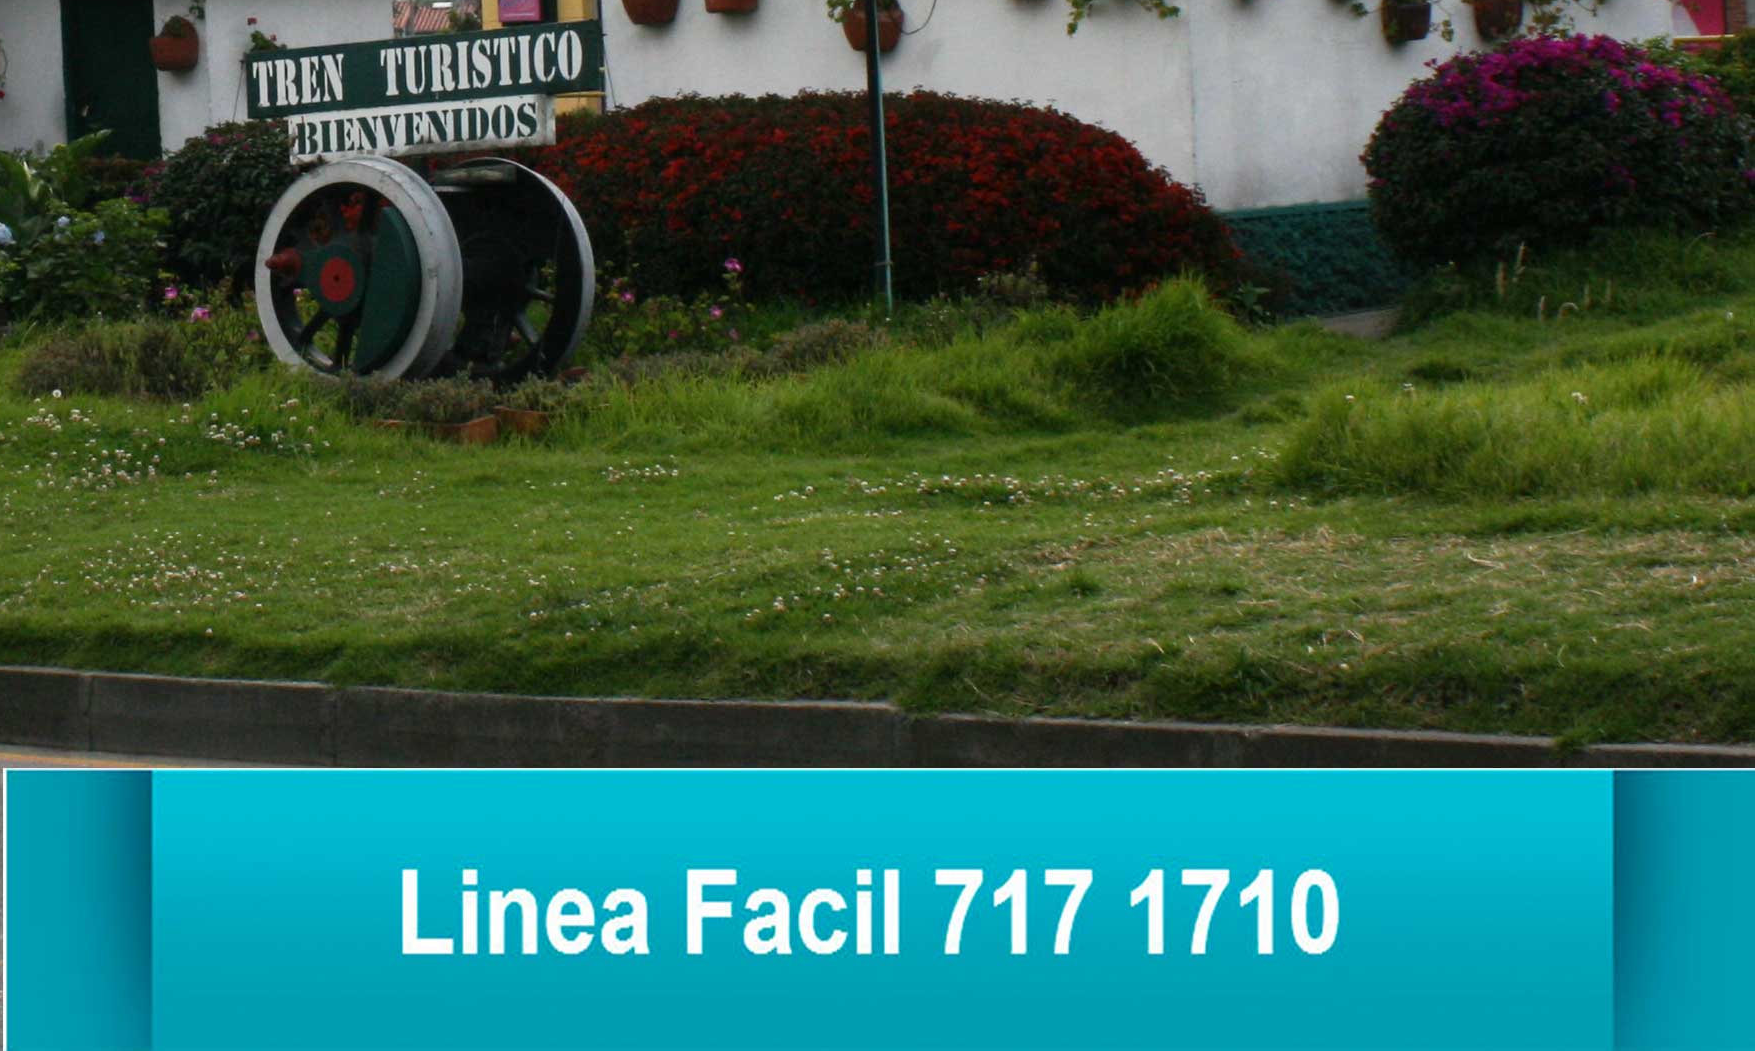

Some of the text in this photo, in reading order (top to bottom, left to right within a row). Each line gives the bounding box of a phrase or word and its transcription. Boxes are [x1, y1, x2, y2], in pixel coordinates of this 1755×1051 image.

[252, 29, 584, 108] TREN TURISTICO
[295, 102, 538, 156] BIENVENIDOS
